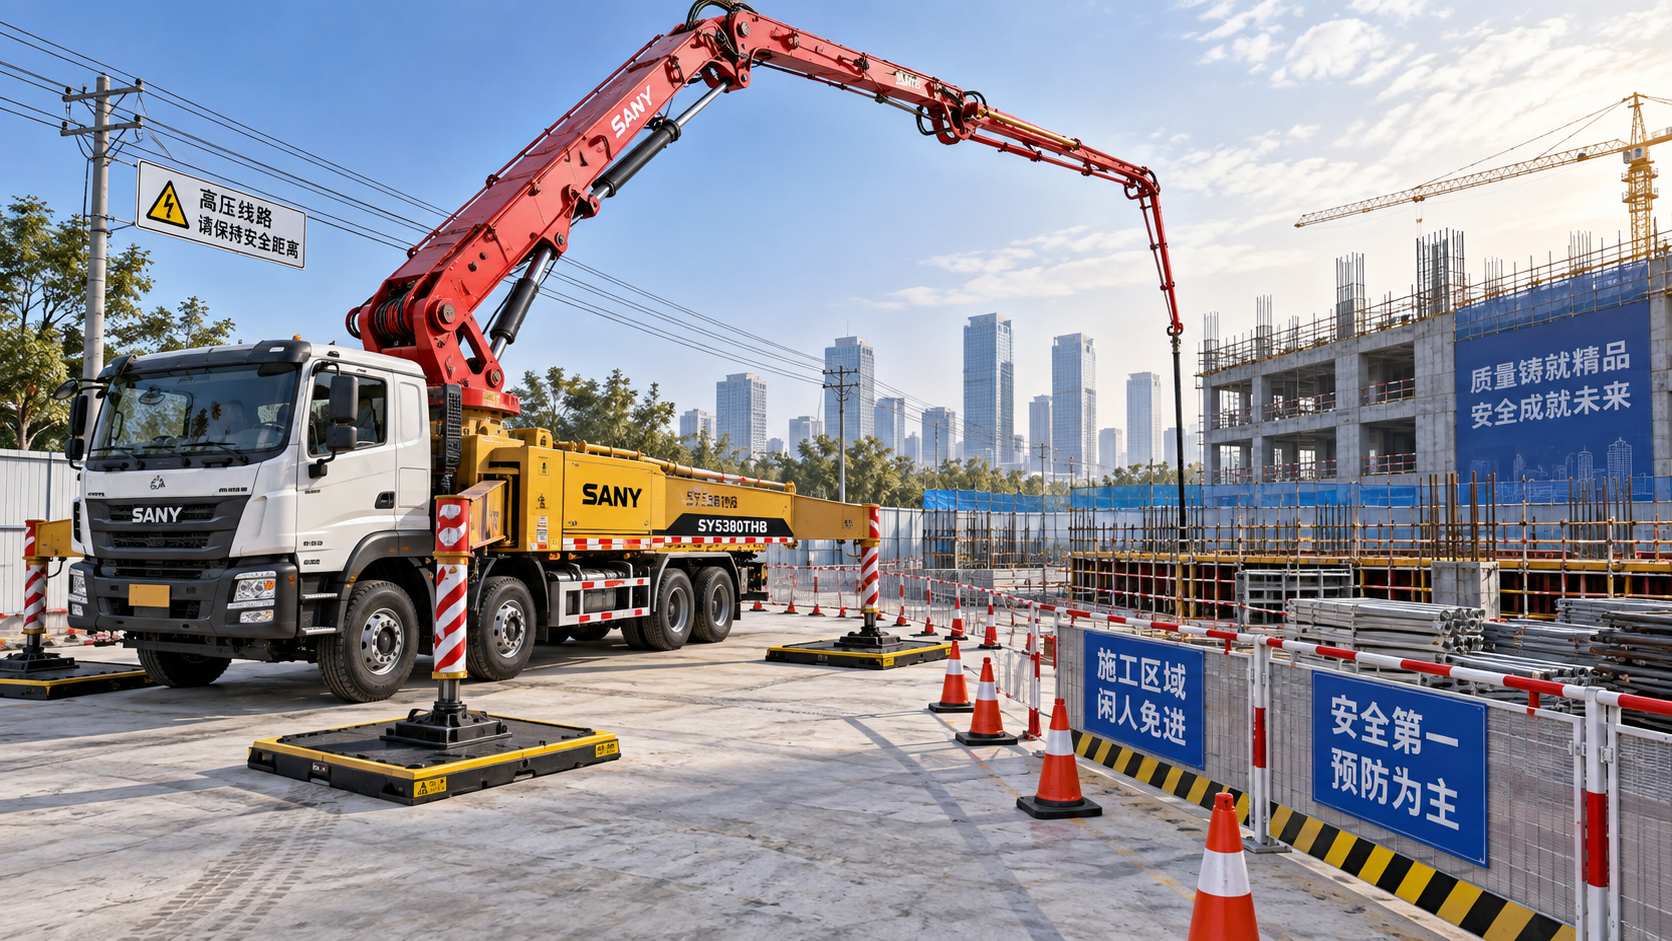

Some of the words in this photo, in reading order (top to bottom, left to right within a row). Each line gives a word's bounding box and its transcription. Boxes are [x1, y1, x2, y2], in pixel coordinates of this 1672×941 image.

[611, 85, 652, 139] SANY
[199, 188, 273, 229] 高压线路
[198, 214, 300, 260] 请保持安全距离
[1470, 340, 1631, 394] 质量铸就精品
[1470, 380, 1632, 430] 安全成就未来
[132, 507, 182, 523] SANY
[582, 483, 642, 508] SANY
[697, 519, 768, 534] SY5380THB
[1097, 647, 1187, 701] 施工区域
[1097, 687, 1187, 747] 闲人免进
[1331, 694, 1459, 755] 安全第一
[1331, 747, 1460, 831] 预防为主
